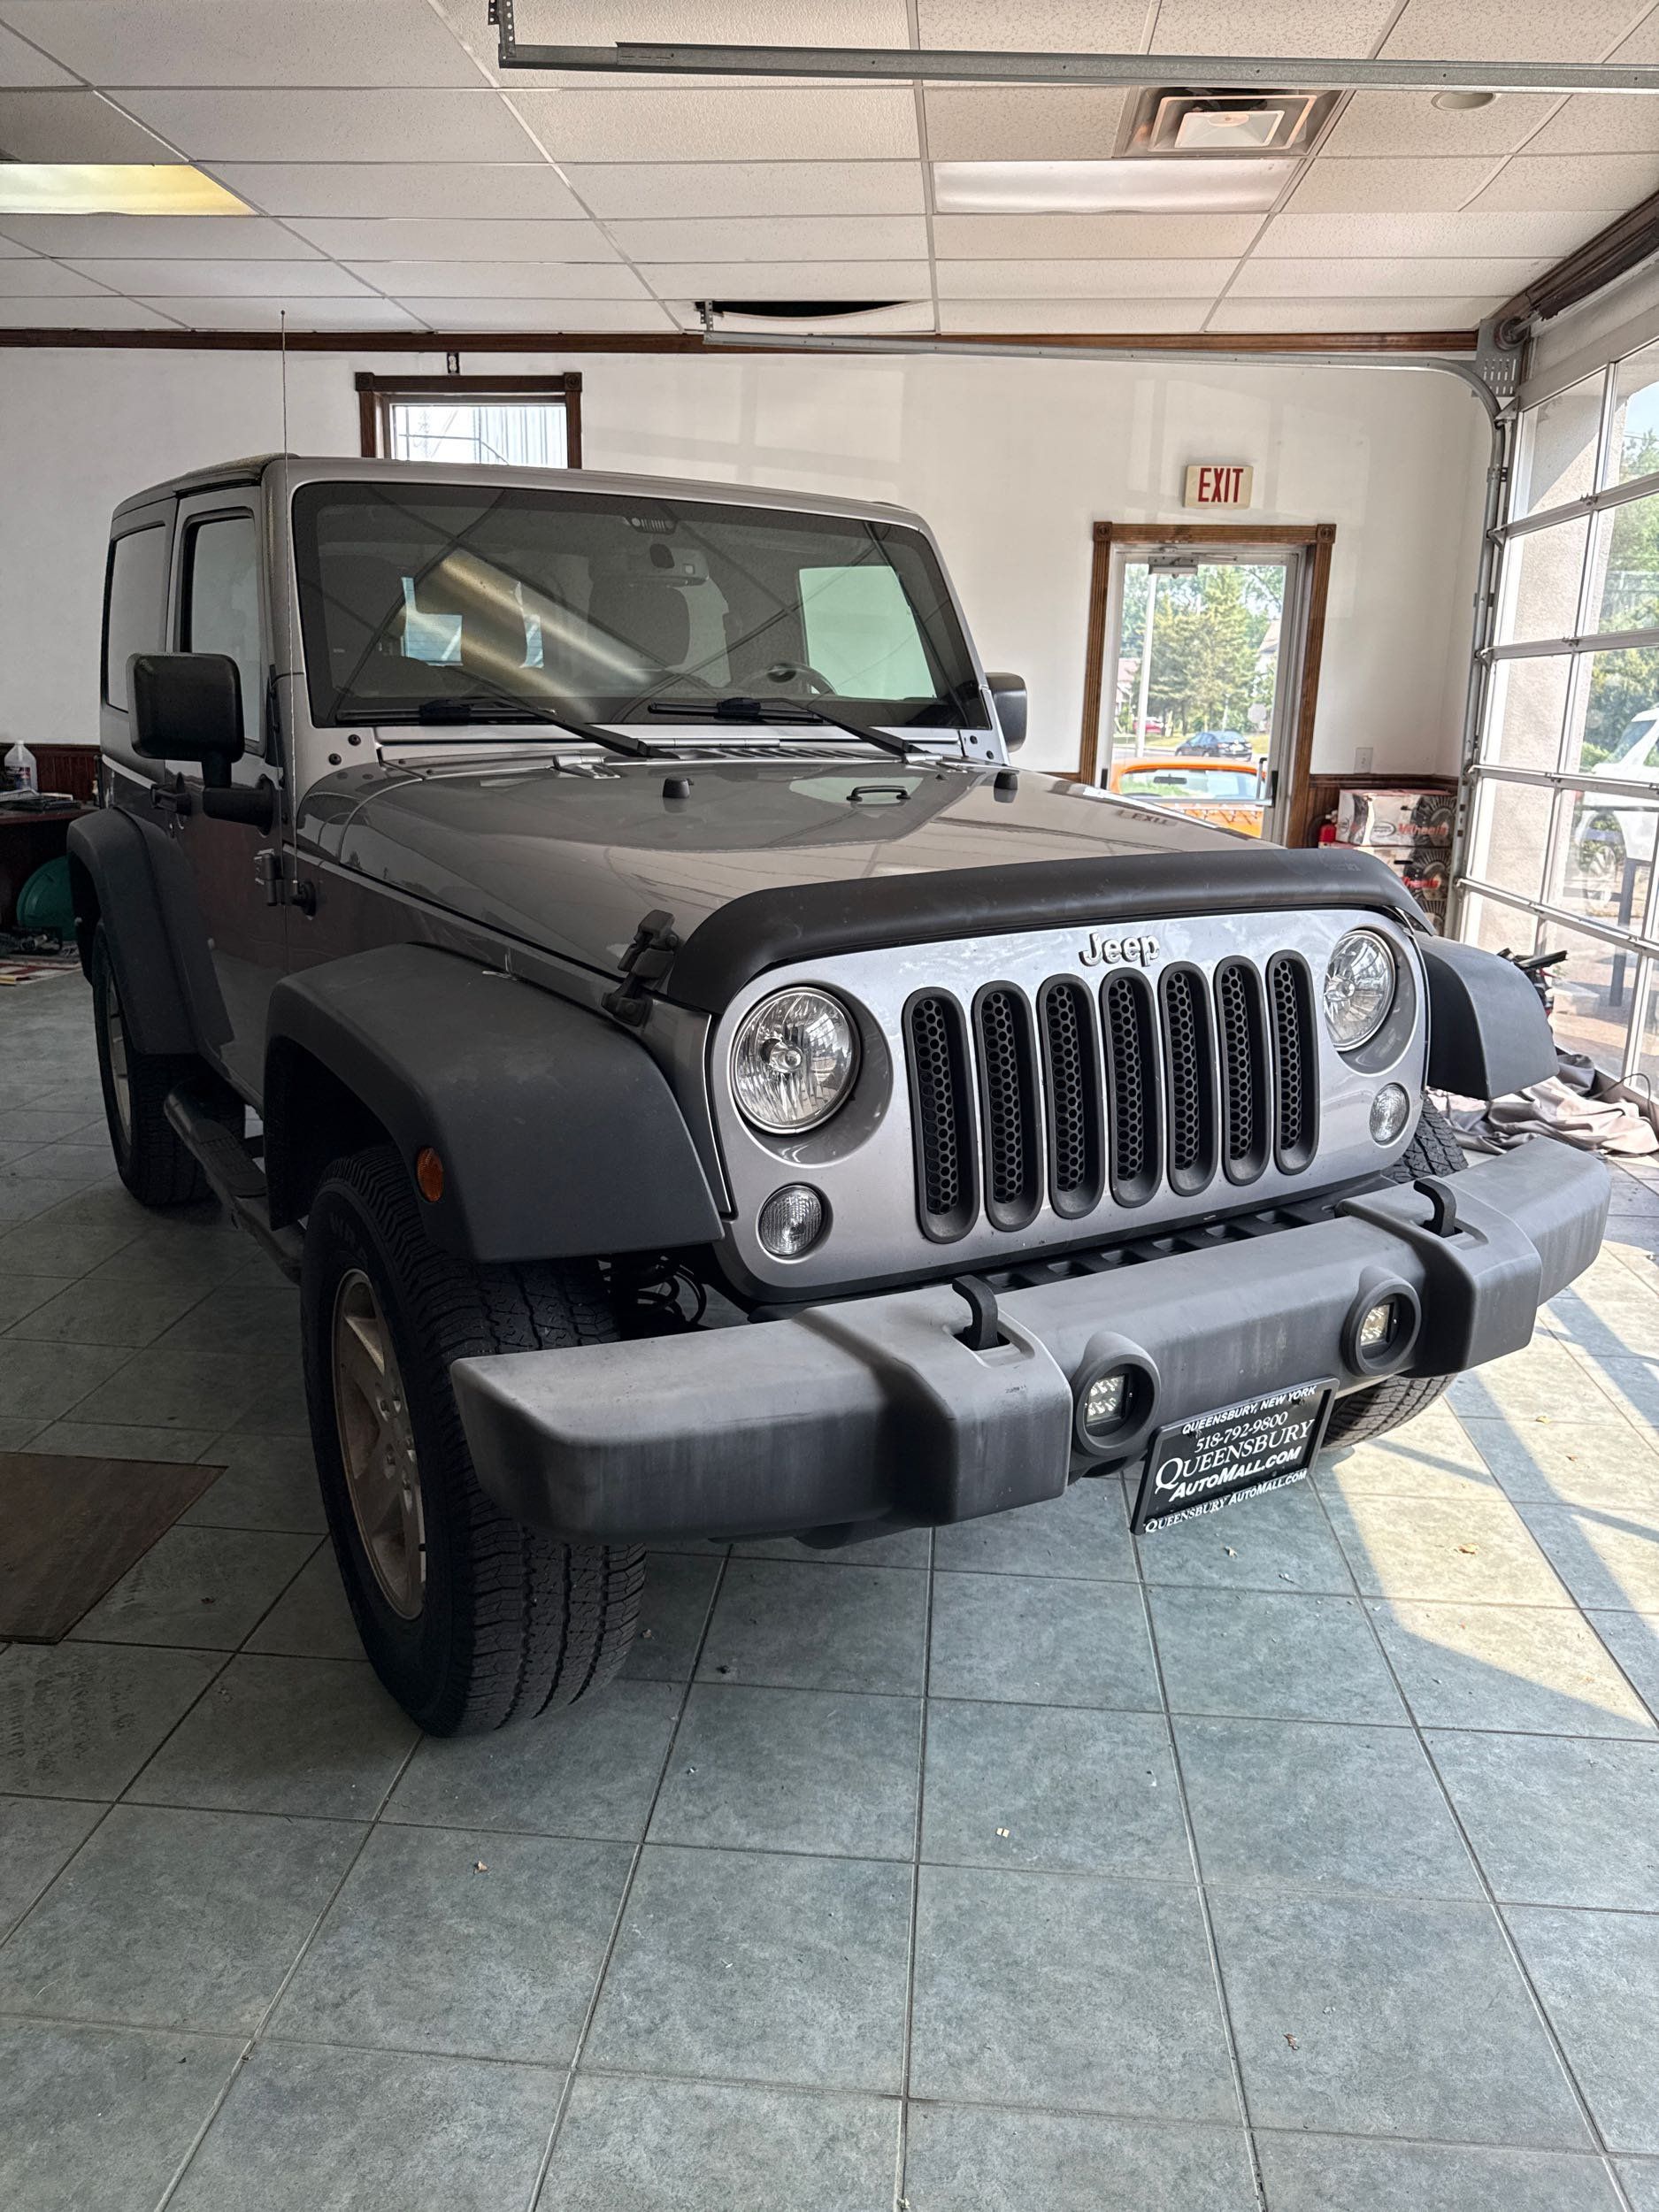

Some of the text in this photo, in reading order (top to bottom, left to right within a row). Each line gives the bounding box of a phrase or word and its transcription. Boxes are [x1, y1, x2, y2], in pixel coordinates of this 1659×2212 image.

[1198, 467, 1244, 503] EXIT
[1079, 933, 1160, 967] Jeep
[1182, 1386, 1317, 1435] QUEENSBURY, NEW YORK
[1194, 1411, 1288, 1454] 518-792-9800
[1155, 1419, 1315, 1494] QUEENSBURY
[1144, 1497, 1230, 1533] QUEENSBURY
